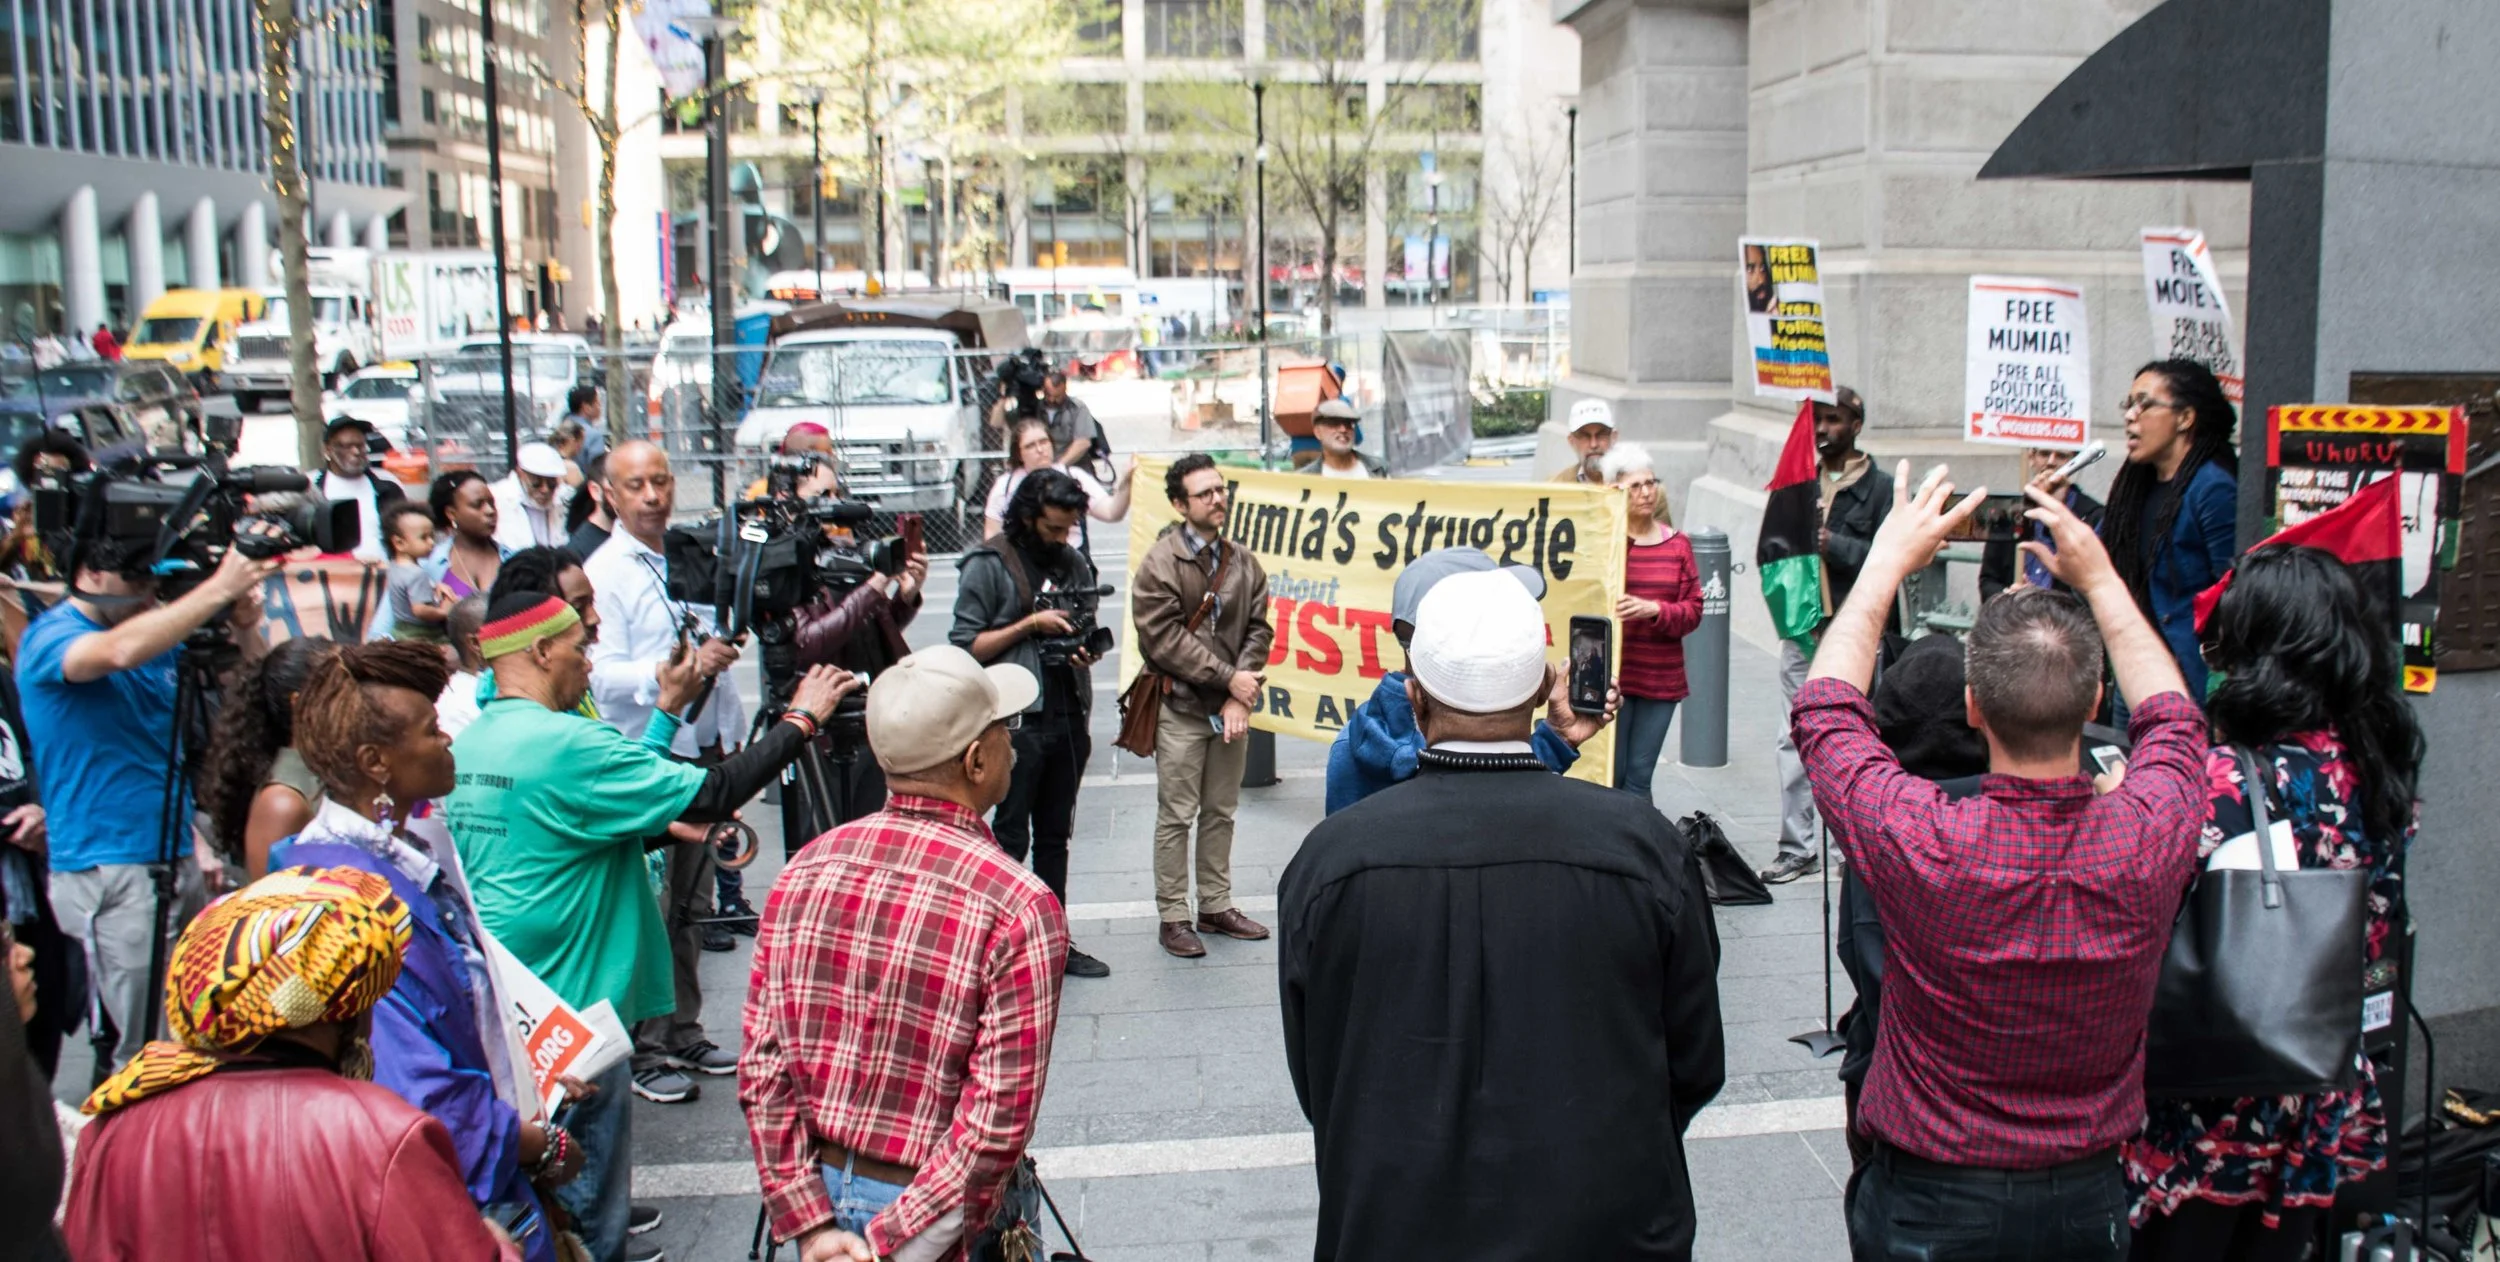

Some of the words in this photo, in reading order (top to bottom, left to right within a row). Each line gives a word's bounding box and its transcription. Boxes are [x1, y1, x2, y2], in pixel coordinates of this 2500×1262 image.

[2006, 300, 2056, 325] FREE
[1988, 328, 2071, 355] MUMIA!
[1997, 363, 2029, 381] FREE
[2035, 365, 2061, 383] ALL
[1990, 380, 2068, 400] POLITICAL
[1984, 396, 2074, 418] PRISONERS!
[2316, 470, 2350, 488] THE
[1373, 498, 1576, 581] struggle
[1268, 569, 1340, 607] about
